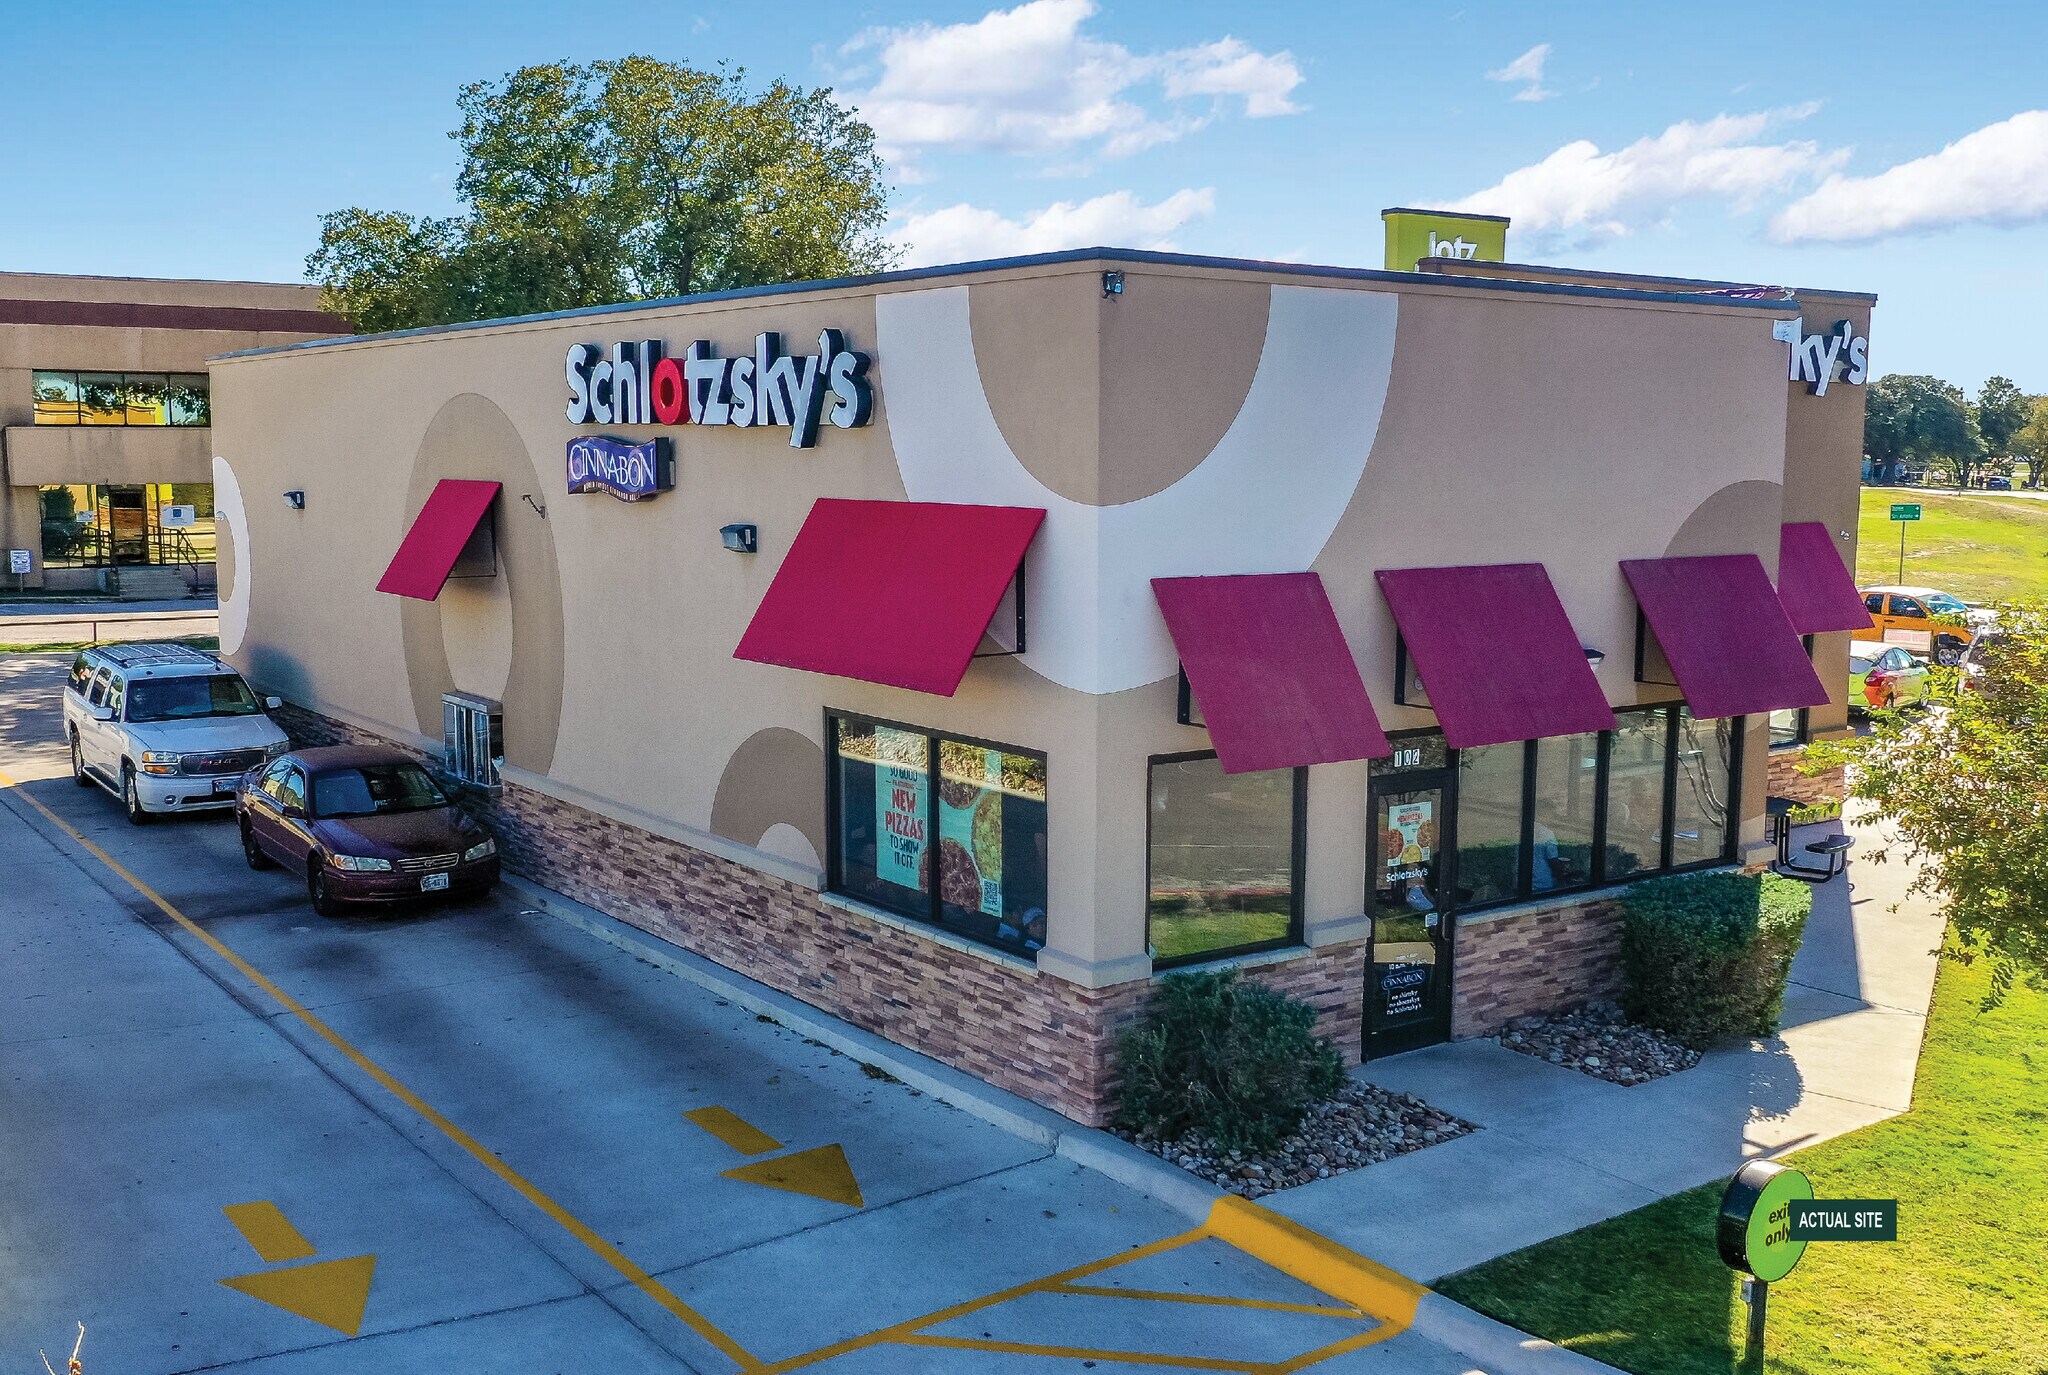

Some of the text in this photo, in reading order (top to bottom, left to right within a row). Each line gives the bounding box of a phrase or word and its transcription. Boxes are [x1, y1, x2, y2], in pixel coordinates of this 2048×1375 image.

[1429, 231, 1478, 259] lotz
[565, 328, 870, 448] Schlotzsky's
[570, 444, 655, 487] CINNABON
[1395, 749, 1419, 767] 102
[892, 788, 916, 813] NEW
[885, 810, 924, 841] PIZZAS
[890, 834, 919, 855] TO SHOW
[894, 851, 901, 866] IT
[1386, 867, 1428, 882] Schlotzsky's
